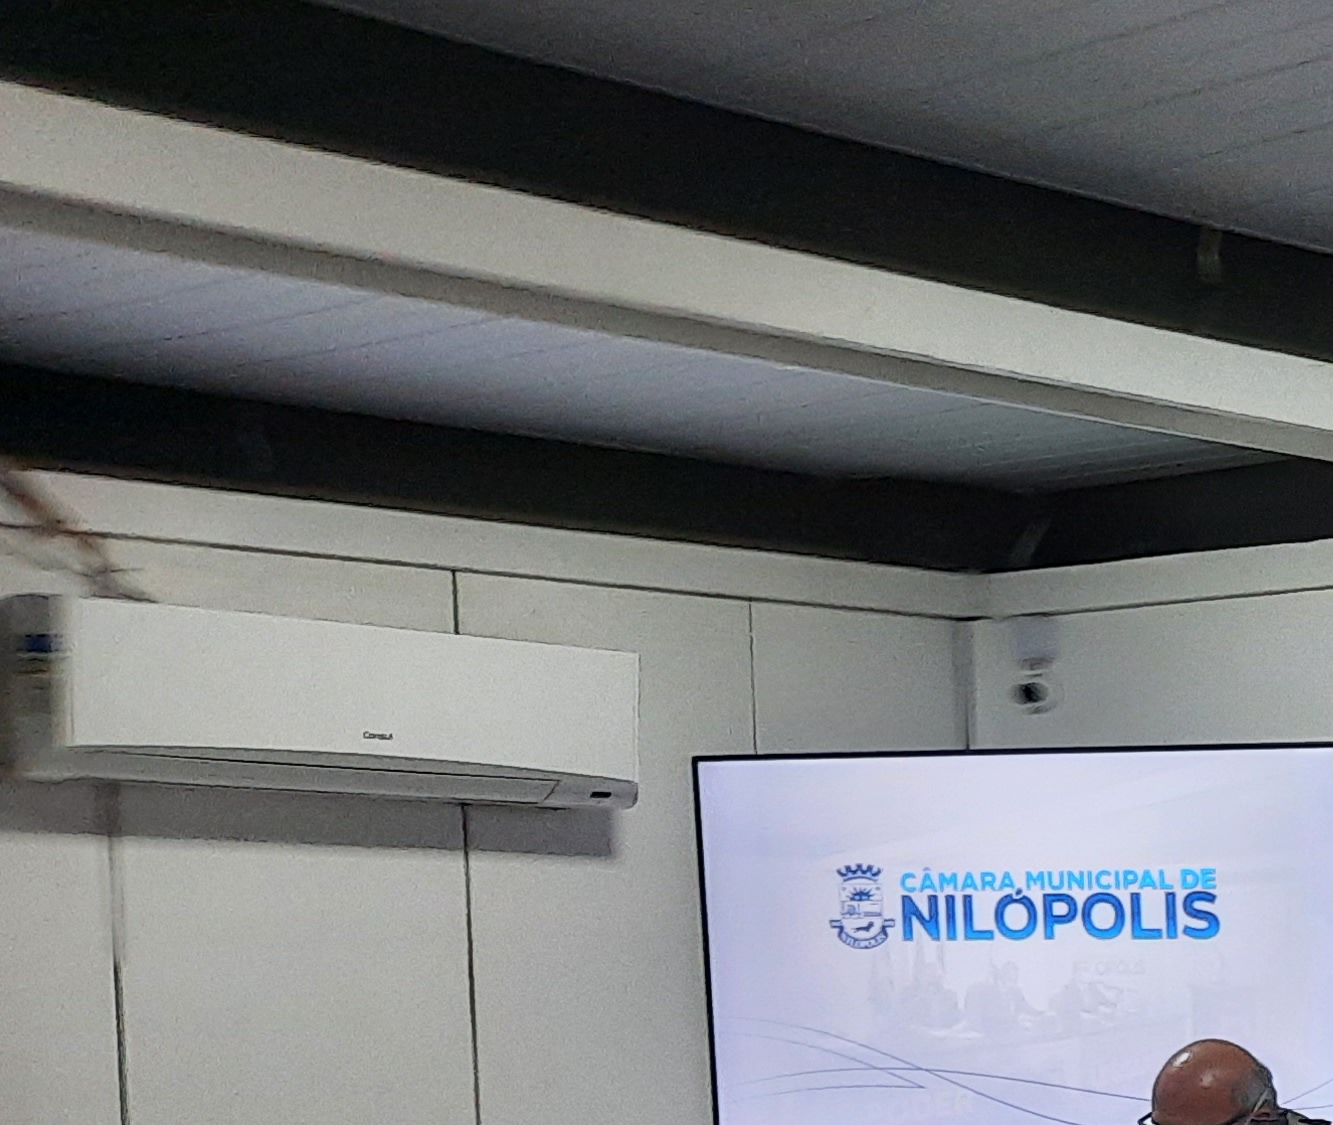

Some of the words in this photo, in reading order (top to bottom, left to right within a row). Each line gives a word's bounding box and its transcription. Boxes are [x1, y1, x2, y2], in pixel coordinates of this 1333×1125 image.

[900, 868, 1016, 892] CÂMARA
[1025, 869, 1173, 891] MUNICIPAL
[1180, 868, 1217, 888] DE
[901, 888, 1220, 941] NILÓPOLIS
